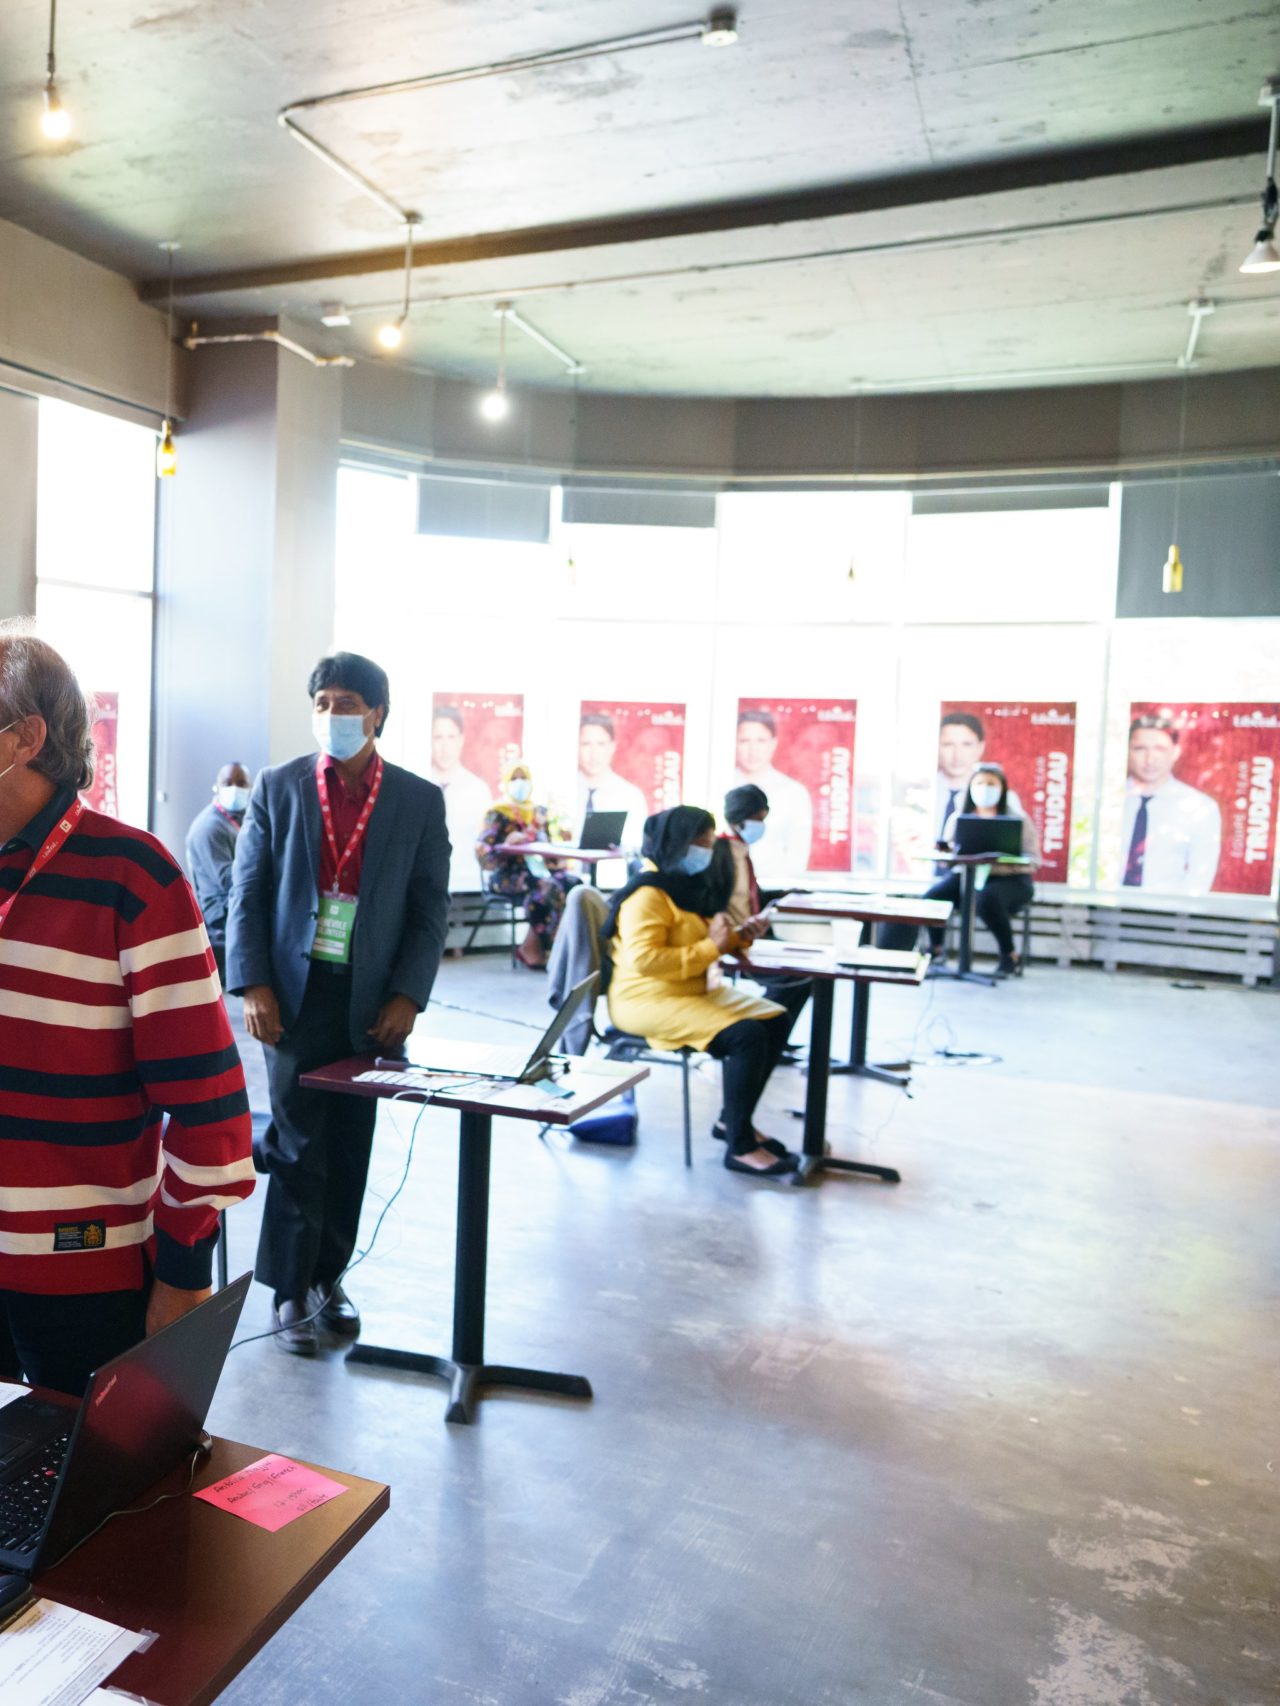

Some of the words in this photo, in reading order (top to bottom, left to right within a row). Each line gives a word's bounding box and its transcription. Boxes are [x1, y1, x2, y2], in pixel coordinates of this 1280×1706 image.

[829, 746, 851, 845] TRUDEAU
[1043, 751, 1068, 854] TRUDEAU
[1245, 756, 1275, 865] TRUDEAU
